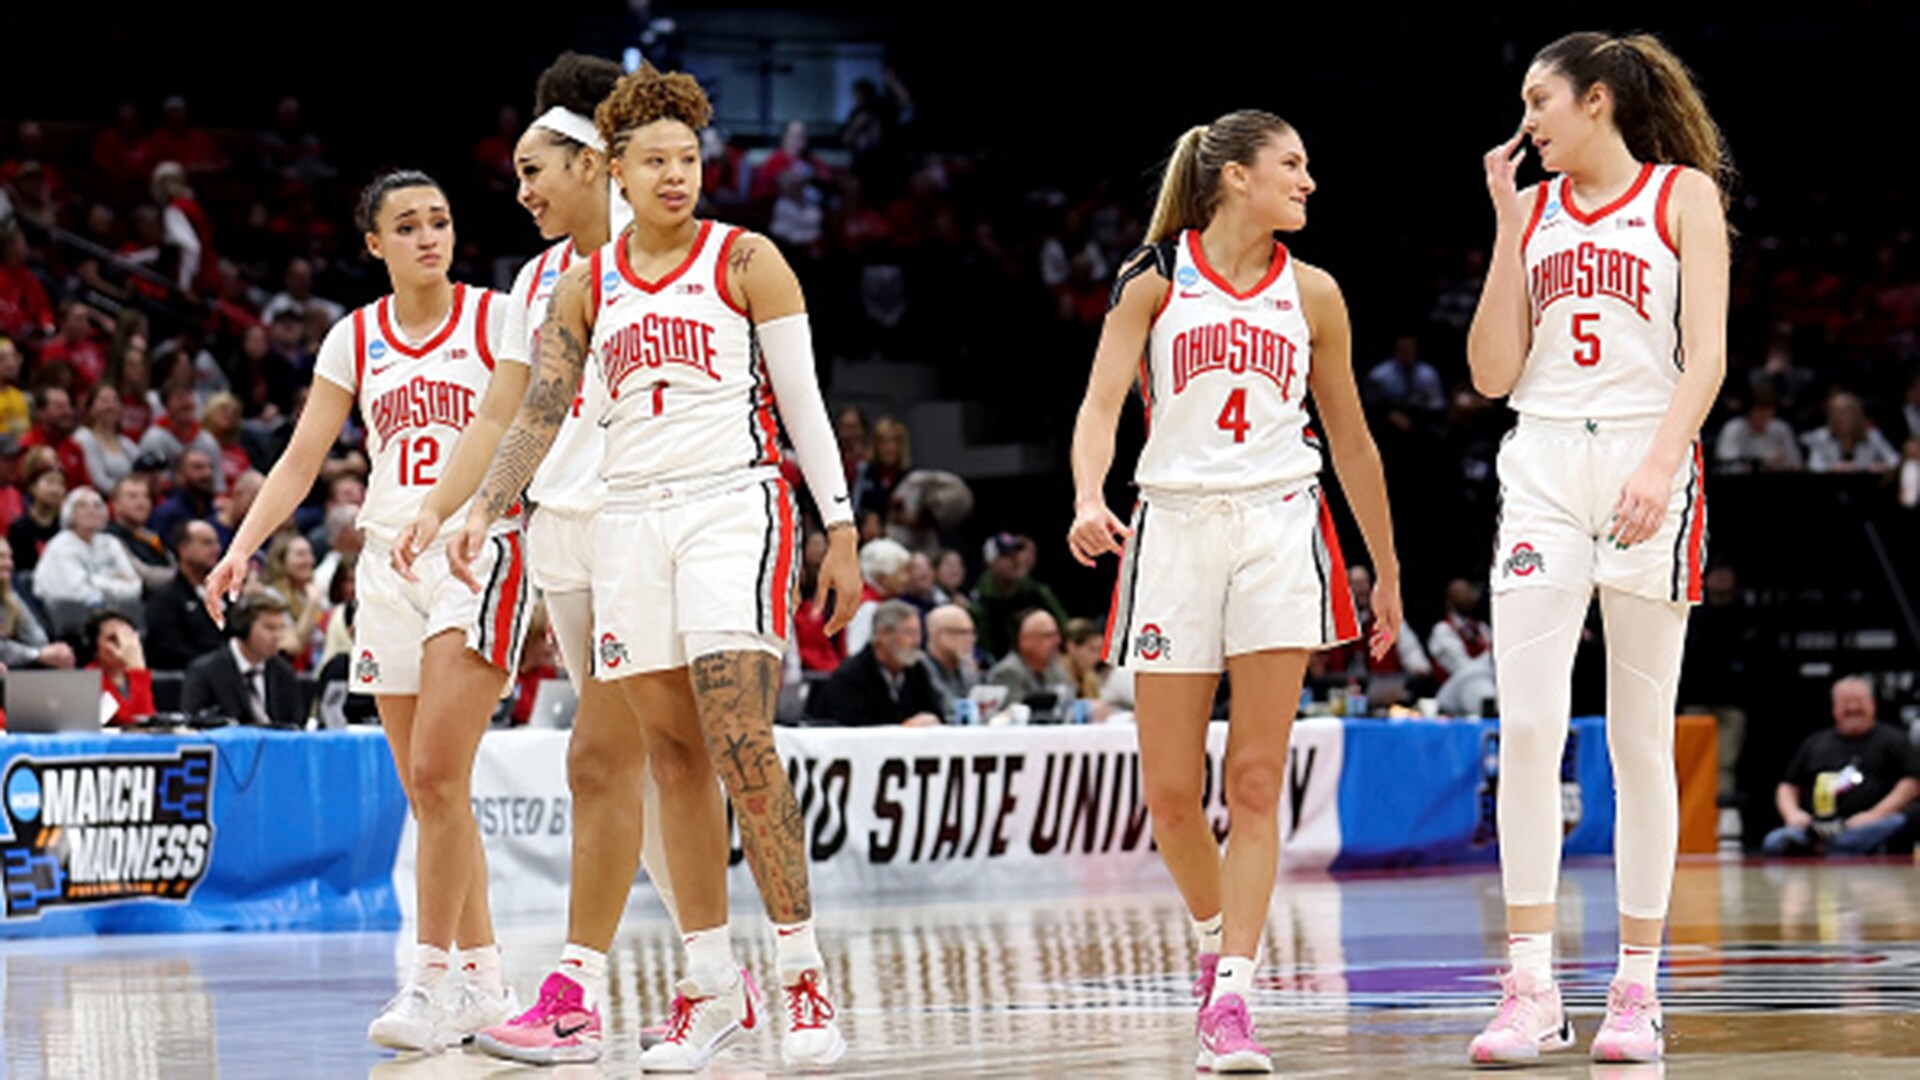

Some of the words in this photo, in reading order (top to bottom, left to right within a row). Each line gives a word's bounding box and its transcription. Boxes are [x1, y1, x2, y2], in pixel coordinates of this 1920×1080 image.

[1572, 313, 1602, 367] 5
[651, 380, 671, 416] 1
[1215, 387, 1252, 444] 4
[398, 436, 440, 487] 12
[42, 767, 156, 825] MARCH
[868, 755, 1025, 864] STATE
[68, 824, 209, 883] MADNESS
